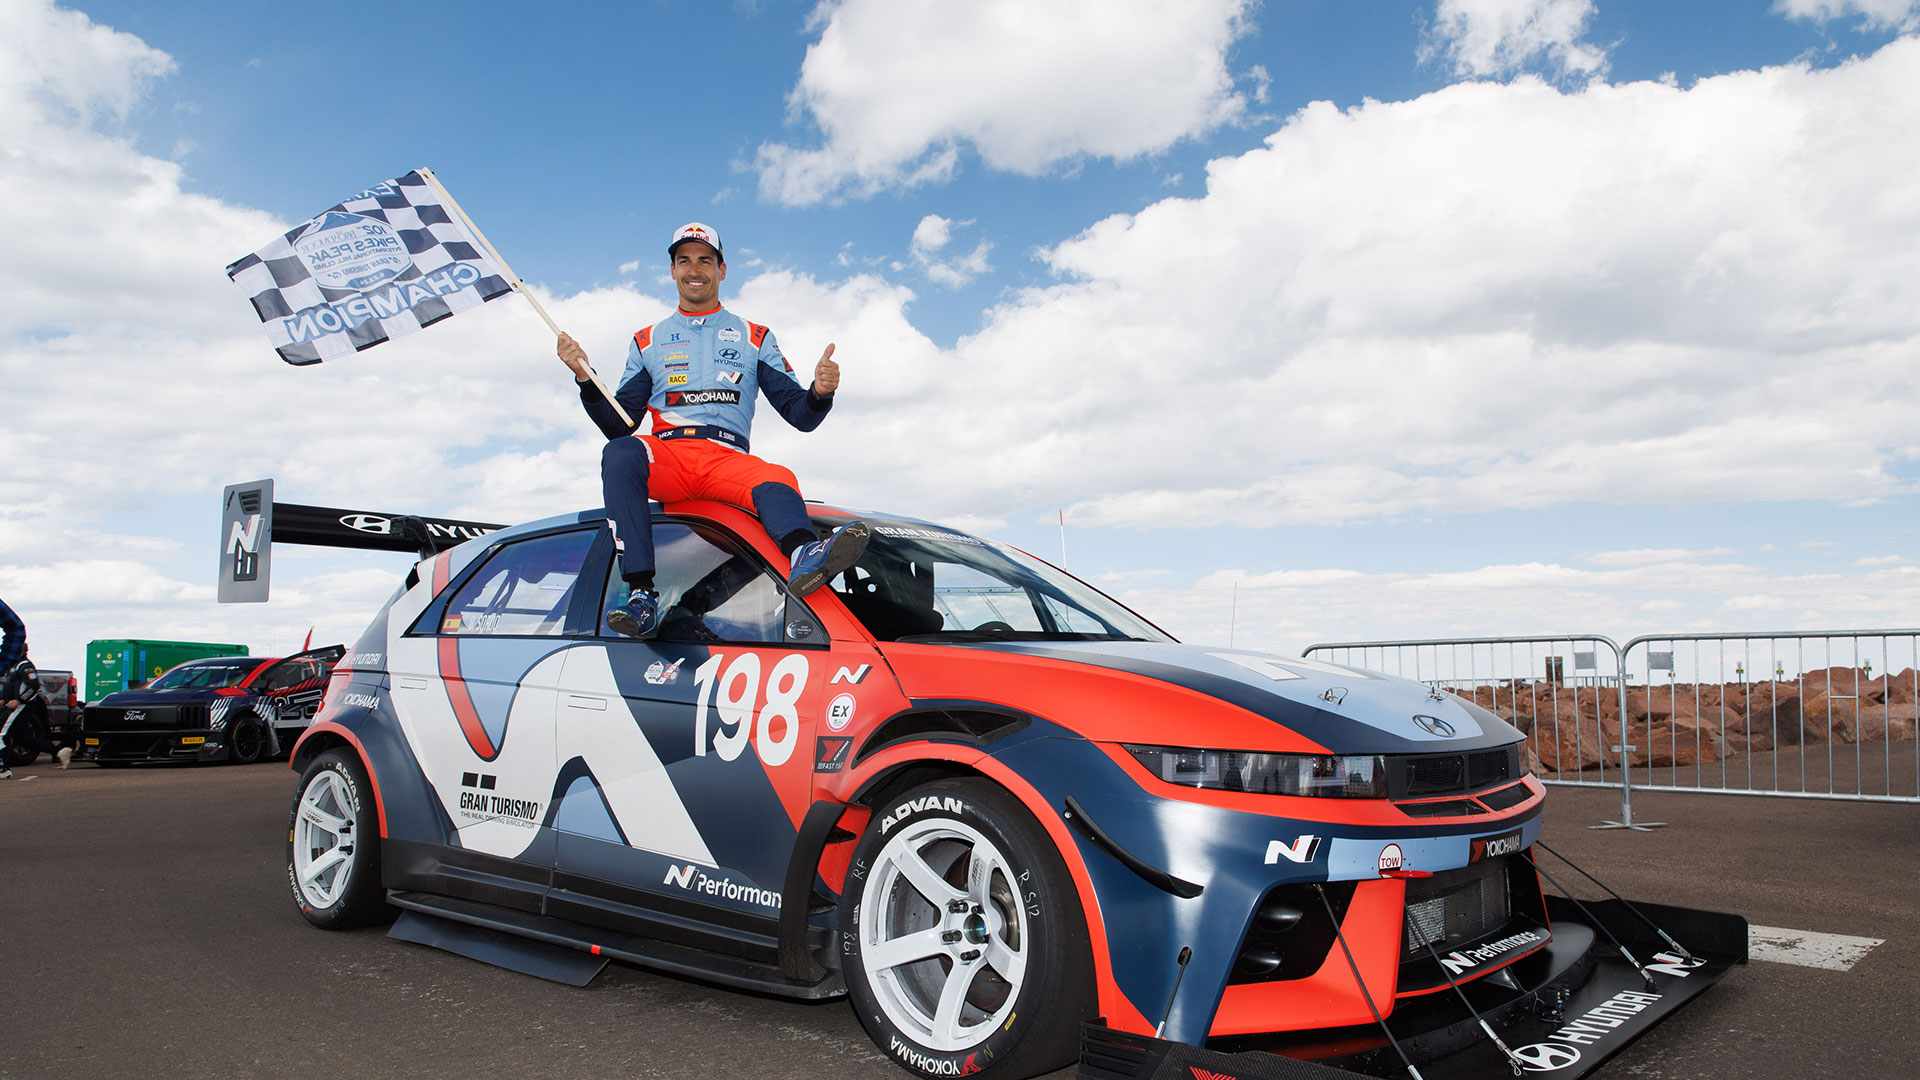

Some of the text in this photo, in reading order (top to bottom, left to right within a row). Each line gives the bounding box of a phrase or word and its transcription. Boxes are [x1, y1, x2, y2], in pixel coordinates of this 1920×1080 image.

[714, 358, 745, 369] HYUNDAI
[669, 375, 686, 384] RACC
[682, 391, 736, 403] YOKOHAMA
[874, 526, 920, 537] GRAN
[124, 709, 146, 721] Ford
[694, 652, 810, 767] 198
[831, 705, 850, 718] EX
[460, 791, 539, 820] GRAN TURISMO
[471, 812, 485, 821] REAL
[881, 796, 963, 836] ADVAN
[1486, 834, 1520, 858] YOKOHAMA
[1380, 857, 1400, 868] TOW
[697, 873, 782, 909] Performan
[843, 931, 858, 956] 198
[1465, 931, 1541, 961] Performance
[1547, 990, 1664, 1045] HYUNDAI
[890, 1036, 961, 1075] YOKOHAMA
